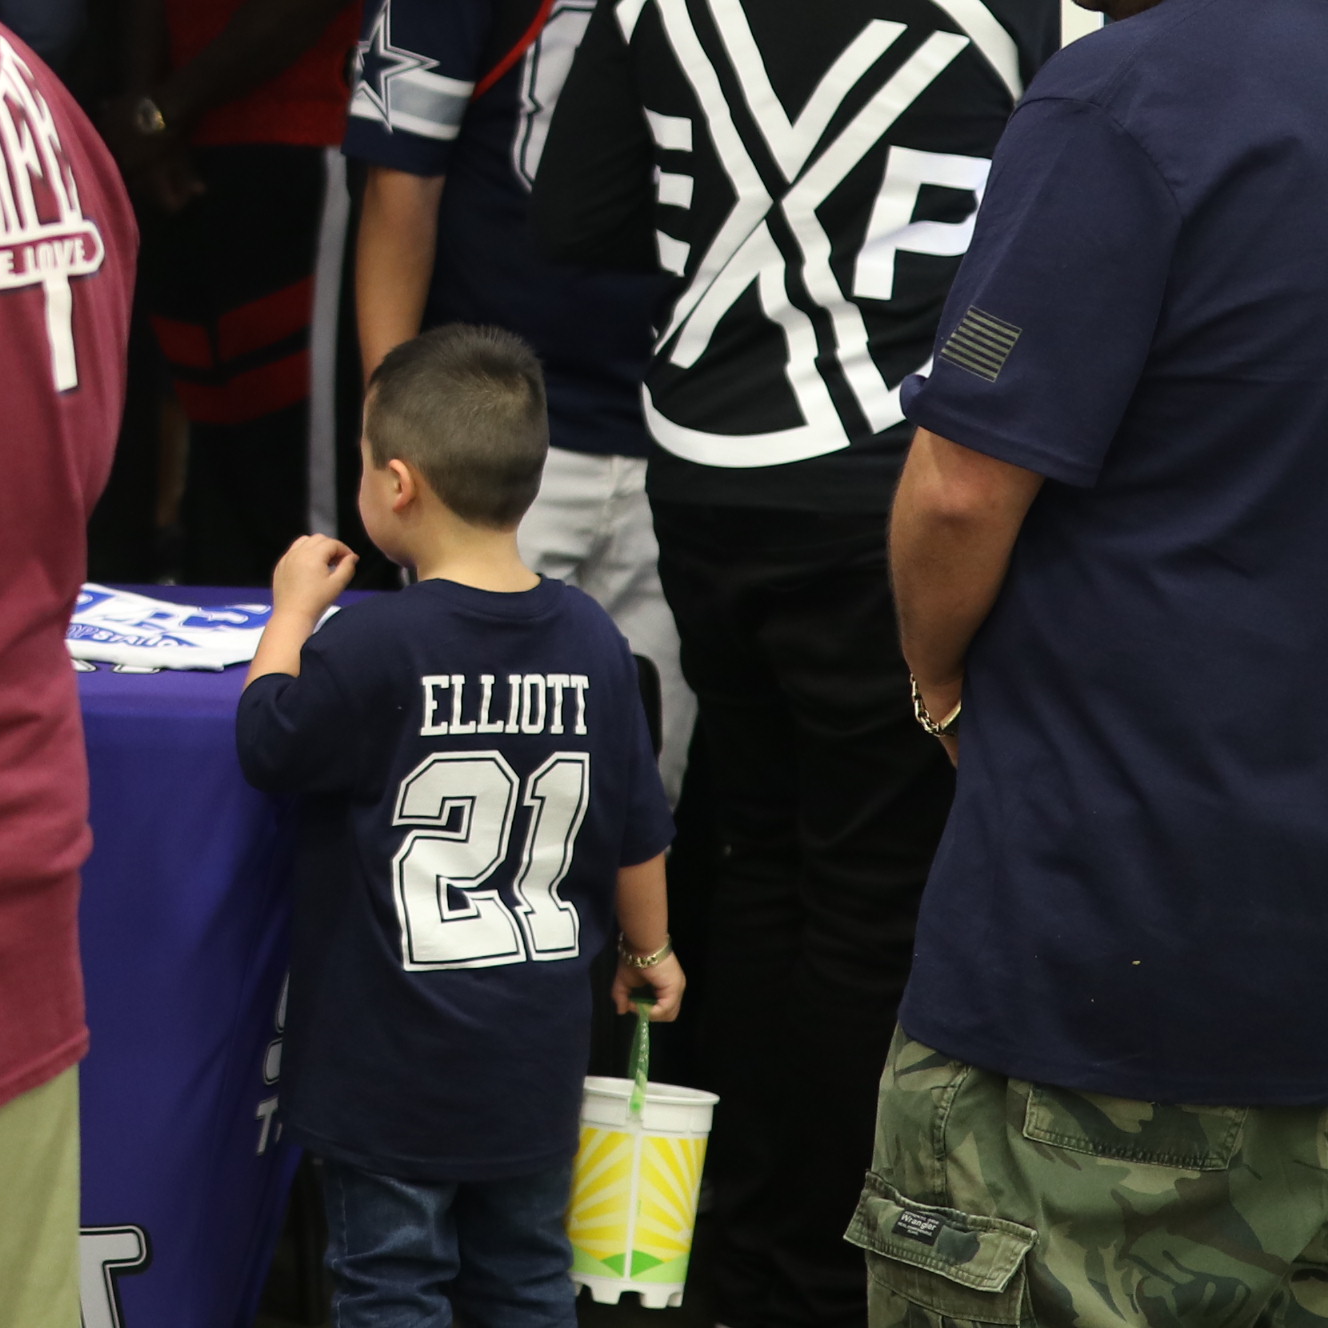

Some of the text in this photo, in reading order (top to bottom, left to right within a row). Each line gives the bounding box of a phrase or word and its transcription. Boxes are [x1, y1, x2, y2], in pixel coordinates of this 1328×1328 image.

[419, 673, 591, 737] ELLIOTT
[392, 750, 591, 972] 21
[900, 1213, 937, 1231] Wrangler
